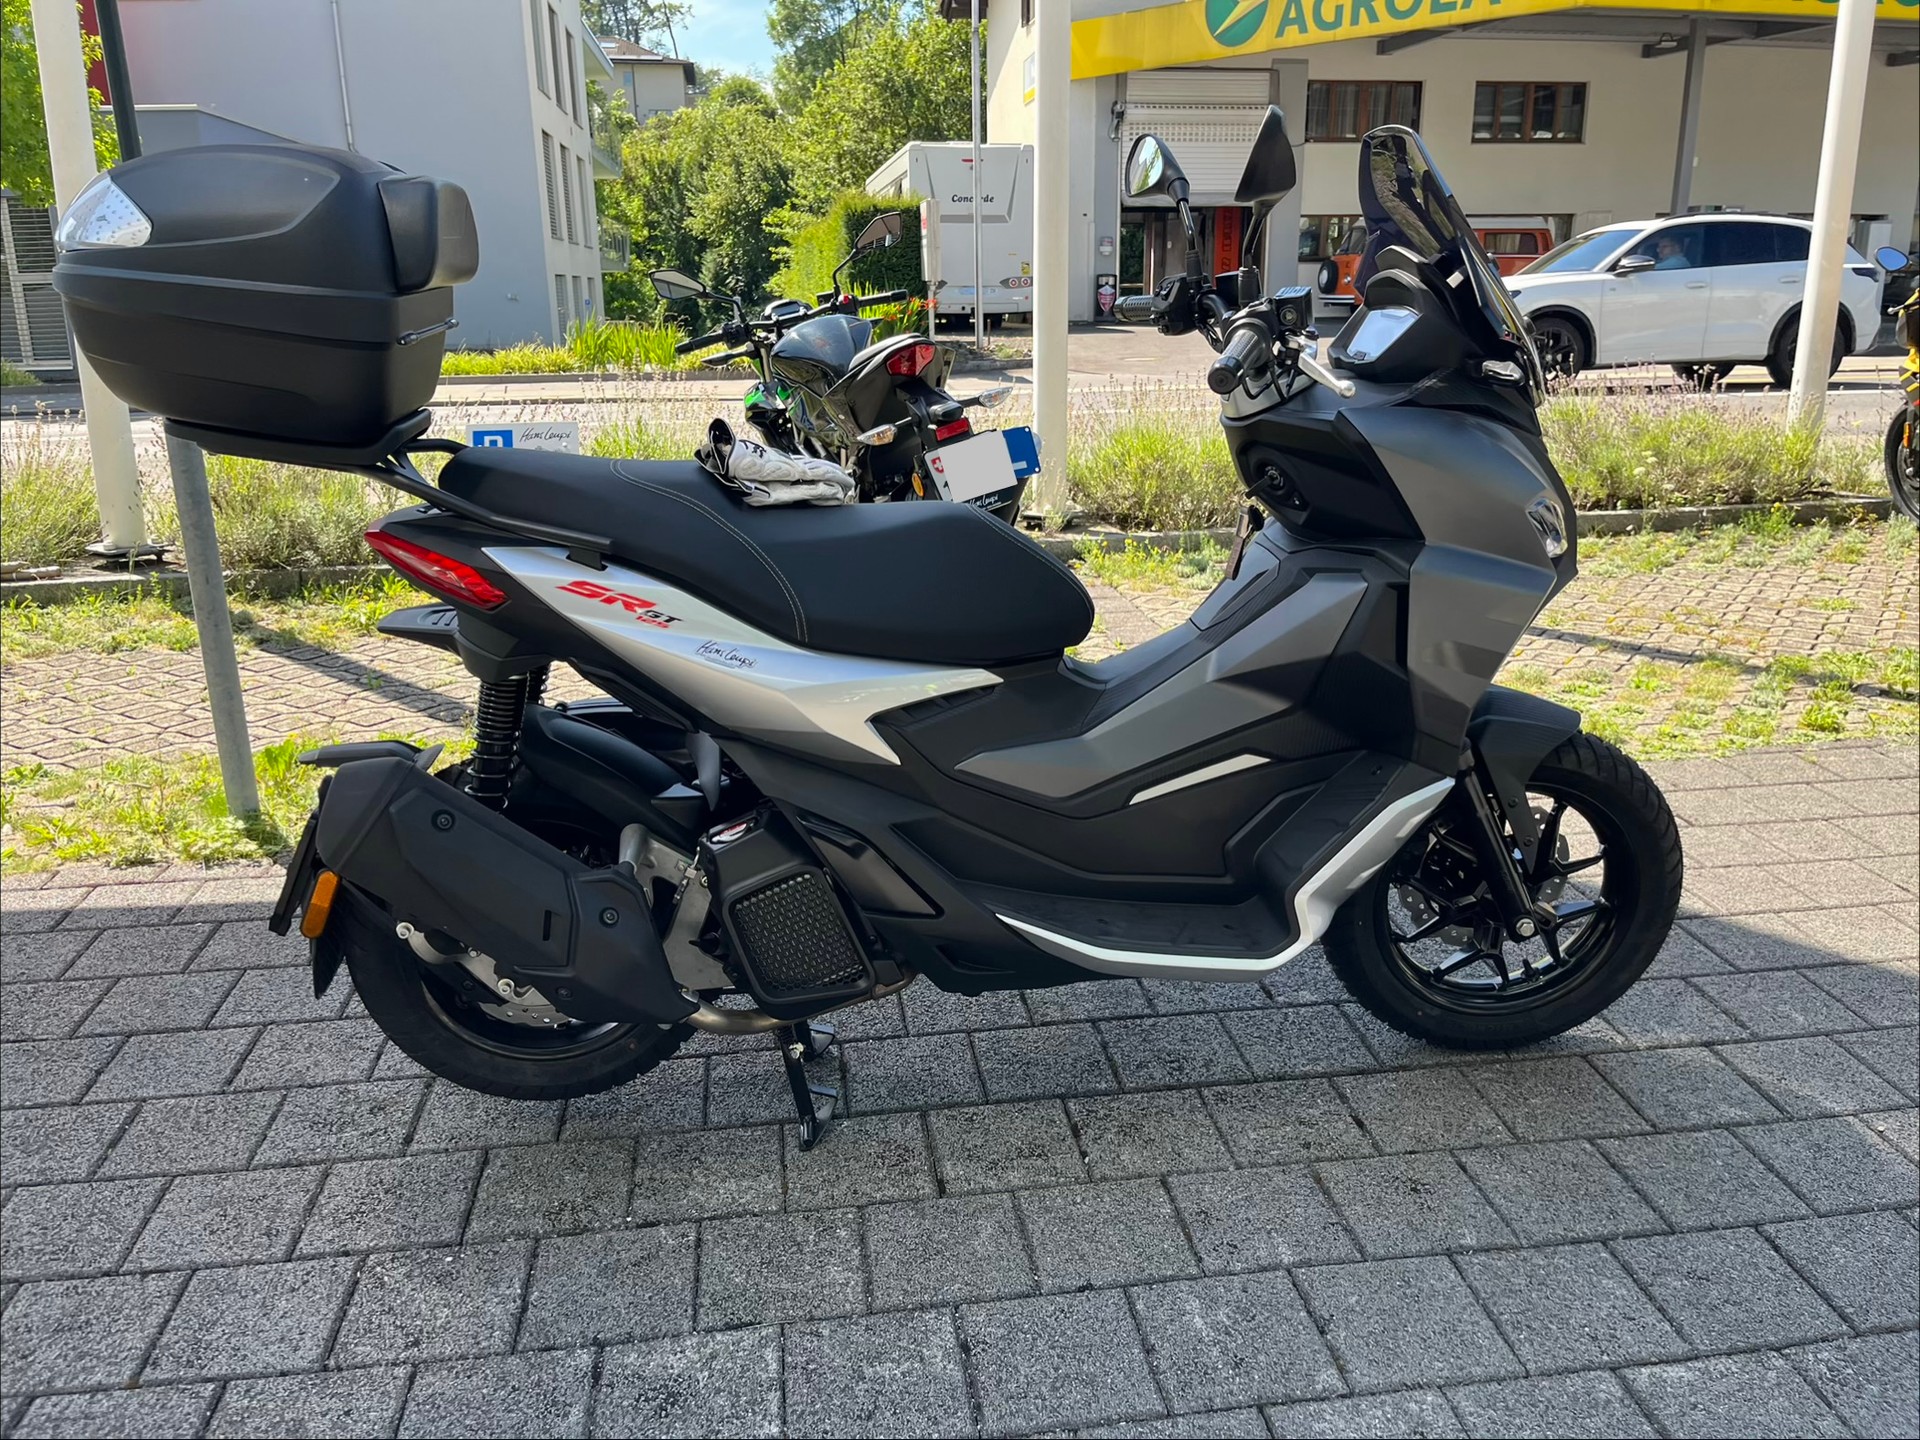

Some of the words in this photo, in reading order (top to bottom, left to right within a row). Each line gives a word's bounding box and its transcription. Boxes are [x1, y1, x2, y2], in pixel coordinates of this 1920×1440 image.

[1275, 0, 1502, 39] AGRO
[951, 194, 995, 204] Concde
[519, 427, 543, 442] Hans
[555, 580, 657, 613] SR
[641, 609, 684, 623] GT
[696, 640, 724, 657] Hans
